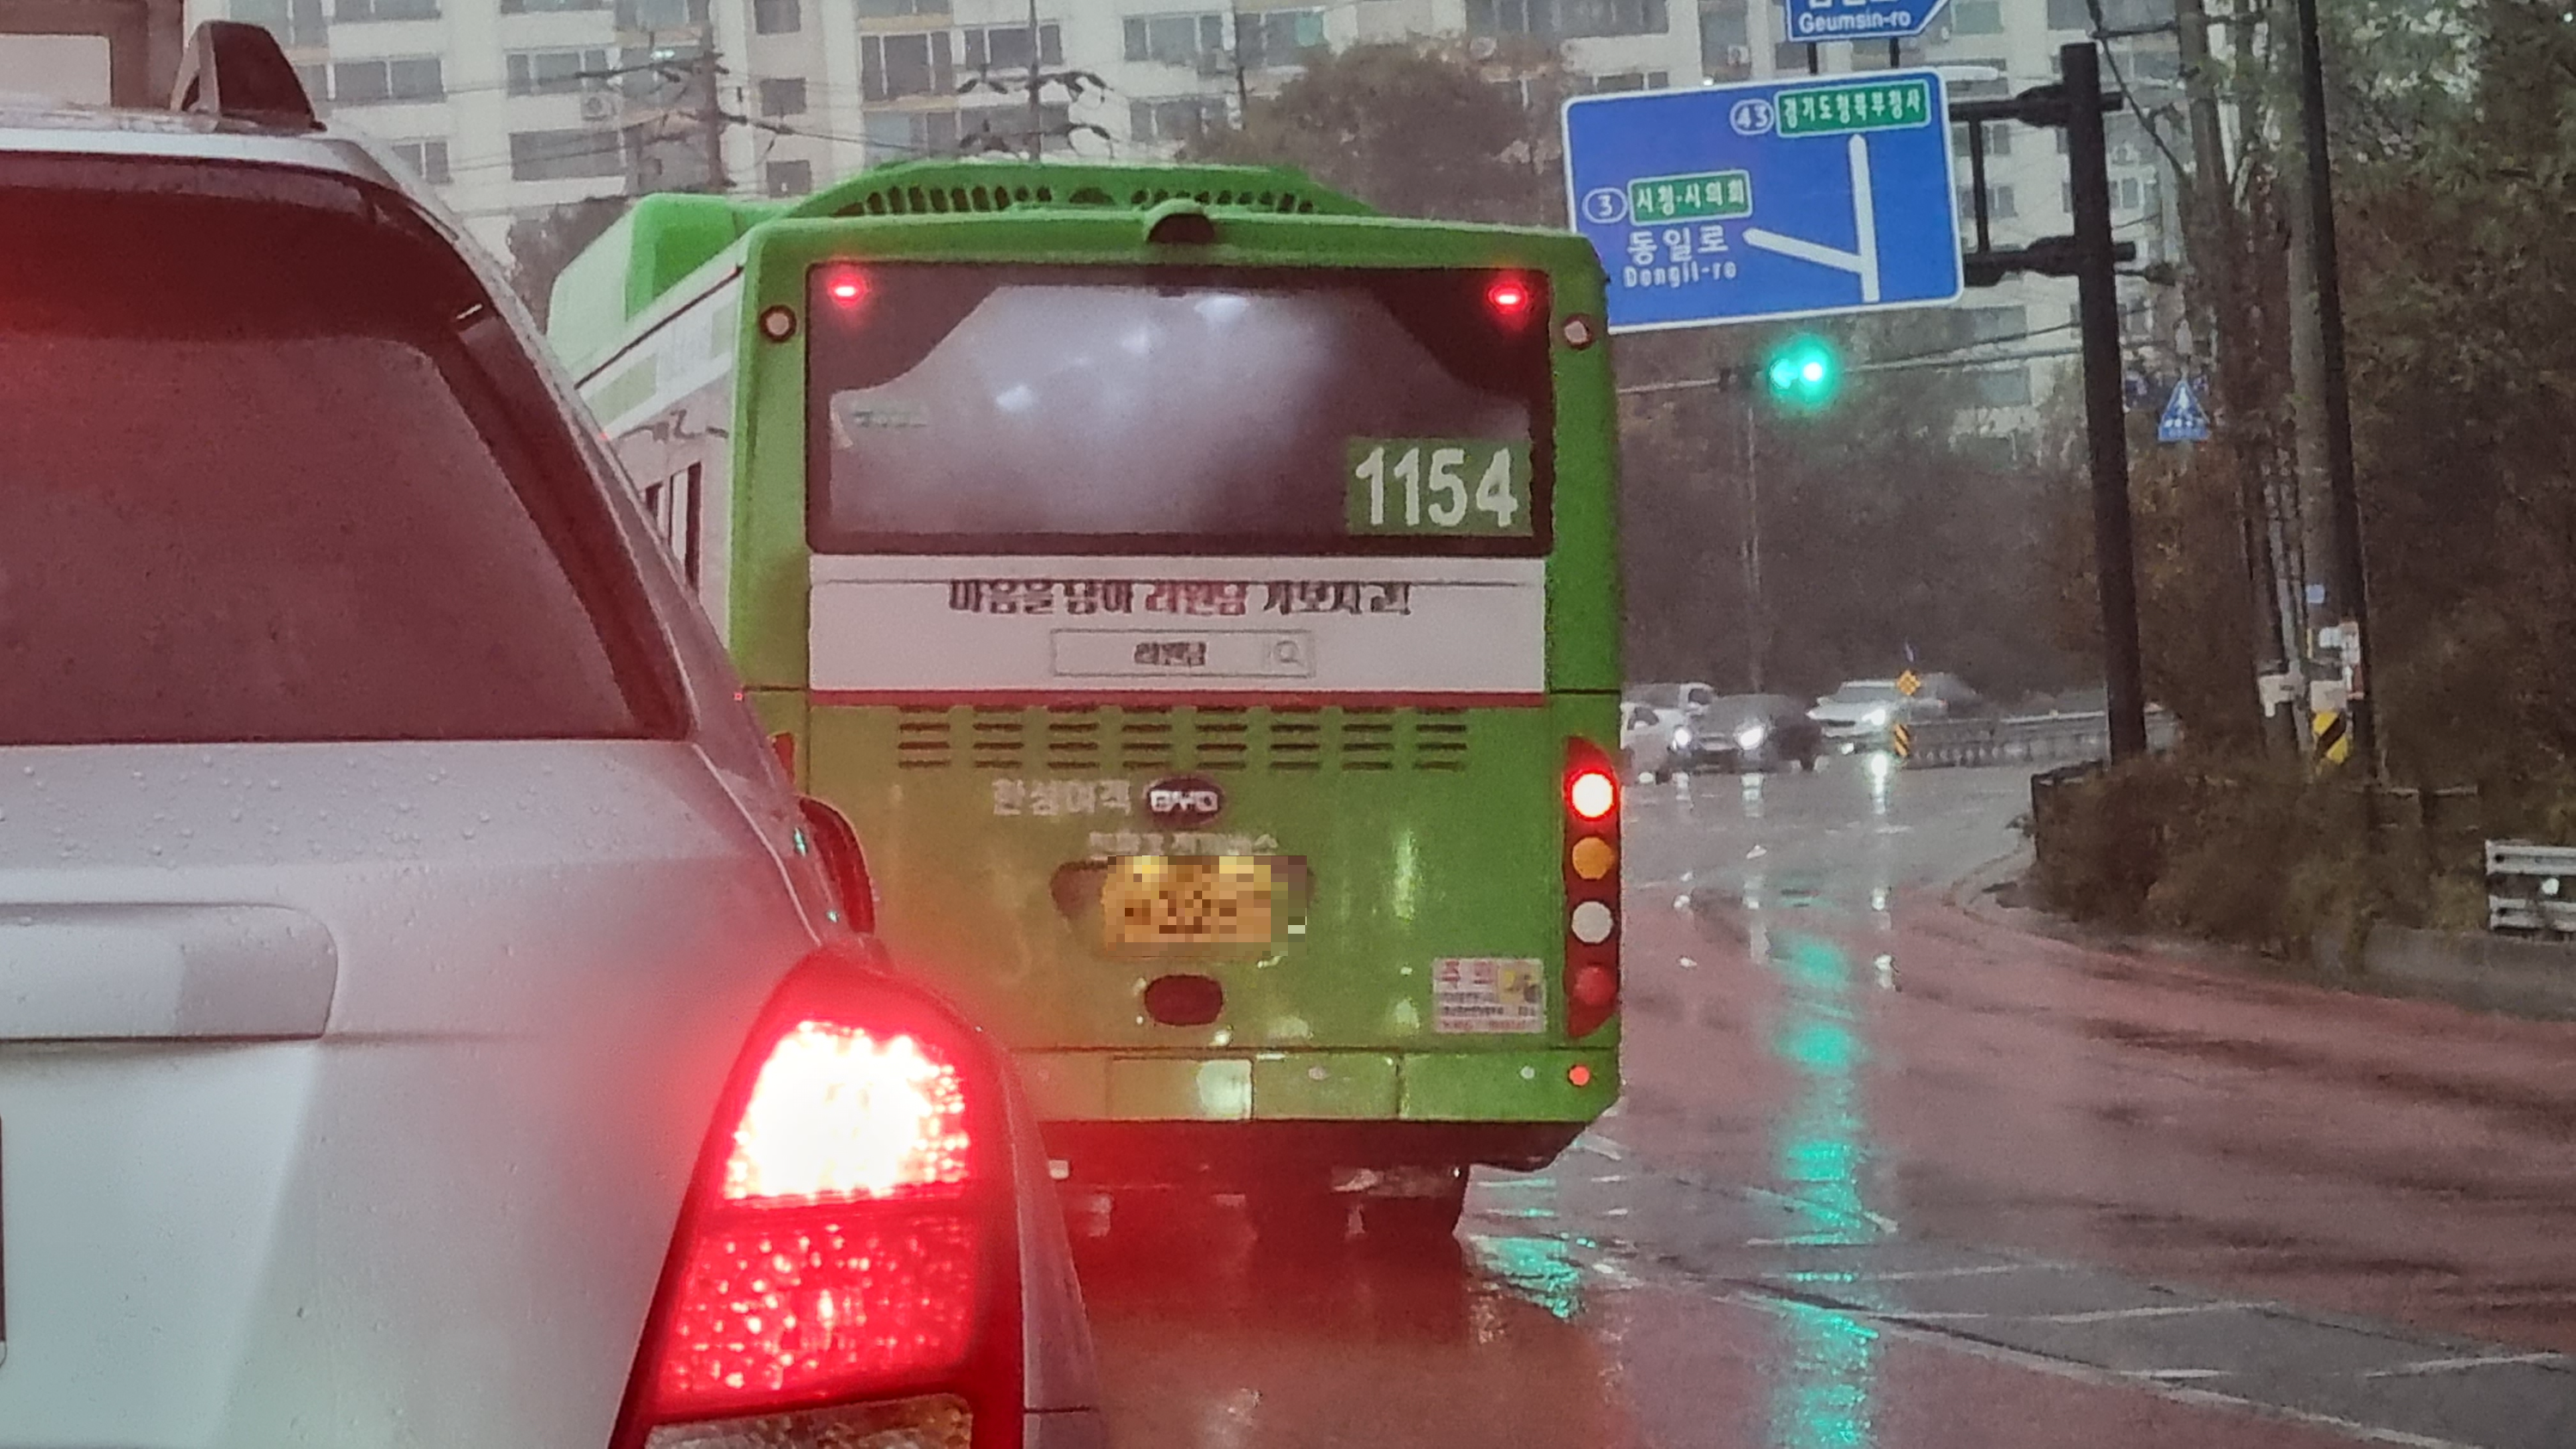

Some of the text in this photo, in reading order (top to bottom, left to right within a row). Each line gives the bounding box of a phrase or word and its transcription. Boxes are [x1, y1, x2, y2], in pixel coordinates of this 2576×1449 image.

[1798, 9, 1911, 33] Geumsin-ro
[1737, 105, 1768, 128] 43
[1598, 194, 1613, 216] 3
[1627, 225, 1728, 265] 동일로
[1624, 260, 1736, 288] Dongil-ro
[1355, 447, 1519, 527] 1154
[1150, 789, 1219, 813] BYD
